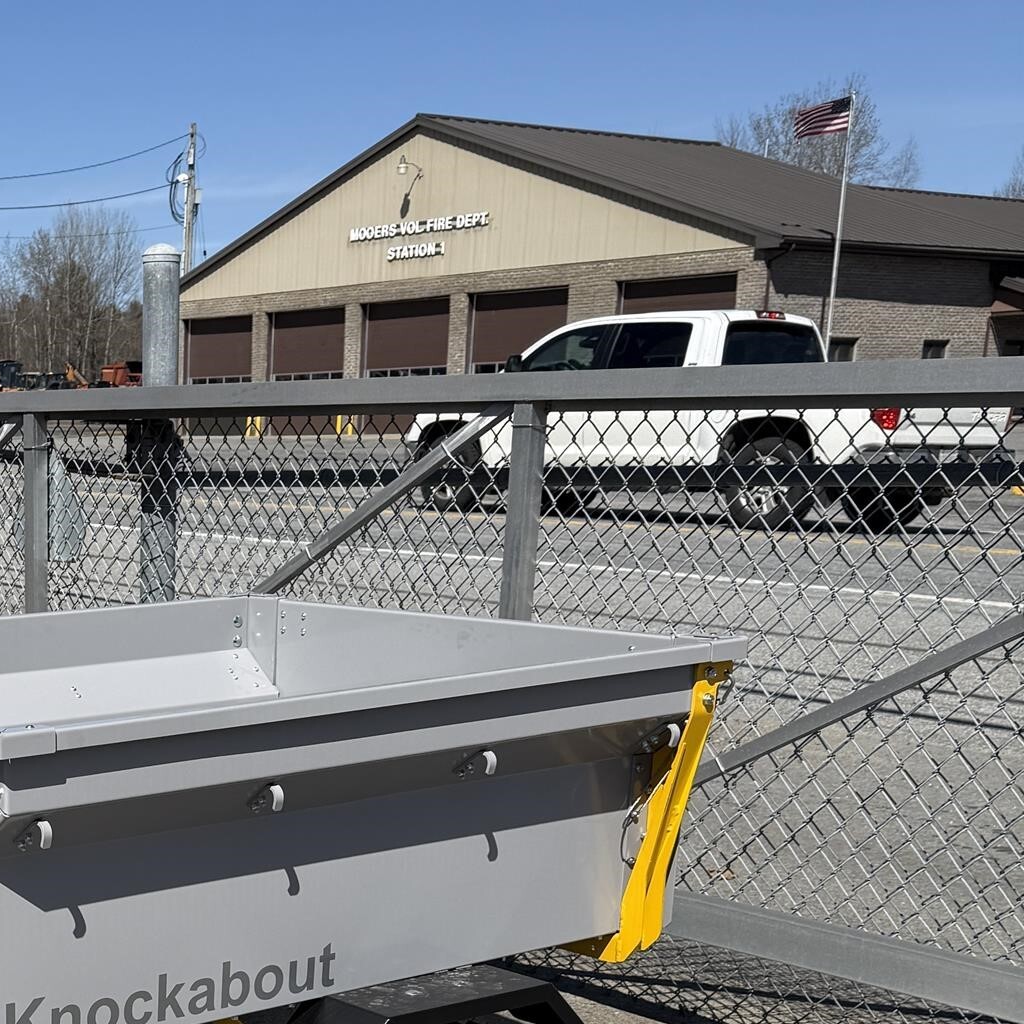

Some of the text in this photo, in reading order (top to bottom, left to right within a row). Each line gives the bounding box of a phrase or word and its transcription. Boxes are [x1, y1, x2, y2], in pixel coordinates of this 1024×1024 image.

[350, 224, 398, 242] MOOERS
[426, 216, 453, 232] FIRE
[456, 211, 489, 228] DEPT.
[387, 241, 446, 261] STATION 1
